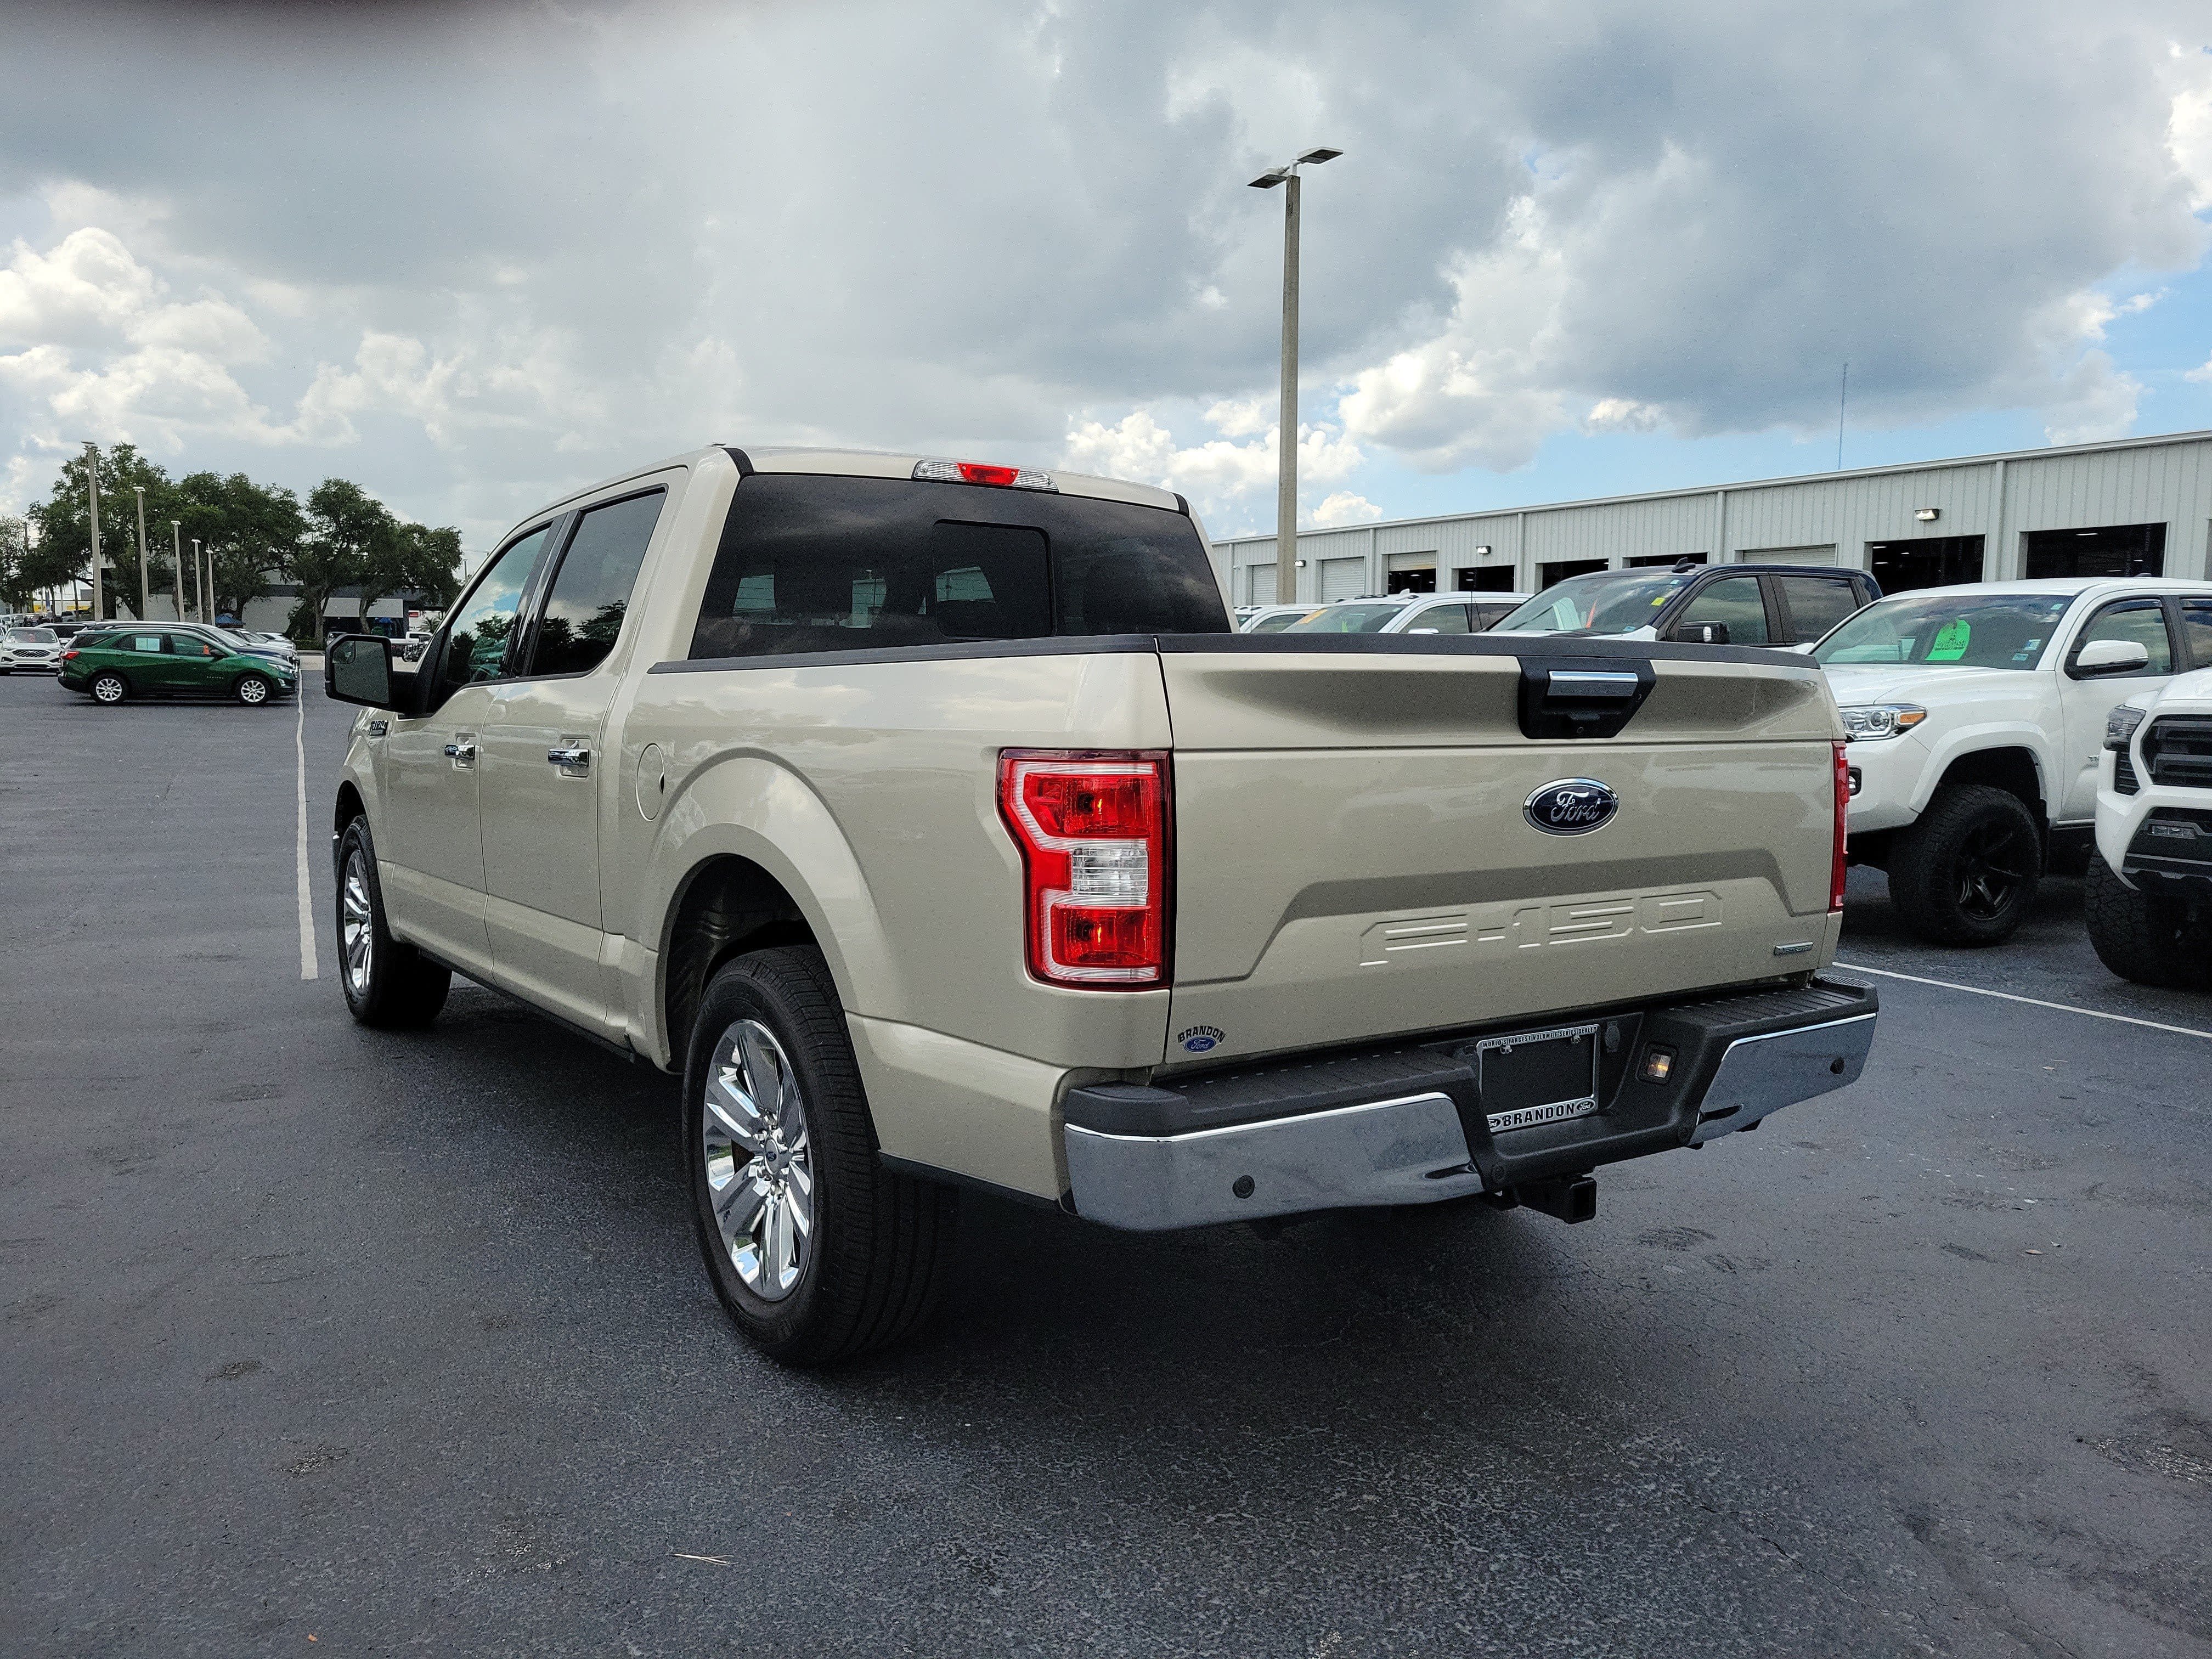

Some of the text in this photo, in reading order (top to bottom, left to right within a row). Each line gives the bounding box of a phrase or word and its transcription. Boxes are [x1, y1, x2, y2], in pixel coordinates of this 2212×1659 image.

[1551, 791, 1601, 822] Ford
[1359, 890, 1723, 966] F-150
[1177, 1025, 1226, 1043] BRANDON
[1190, 1040, 1210, 1049] Ford
[1482, 1039, 1506, 1048] WORLD'S
[1508, 1035, 1531, 1044] LARGEST
[1533, 1031, 1554, 1041] VOLUME
[1578, 1026, 1598, 1035] DEALER
[1502, 1103, 1575, 1127] BRANDON
[1579, 1102, 1592, 1111] Ford
